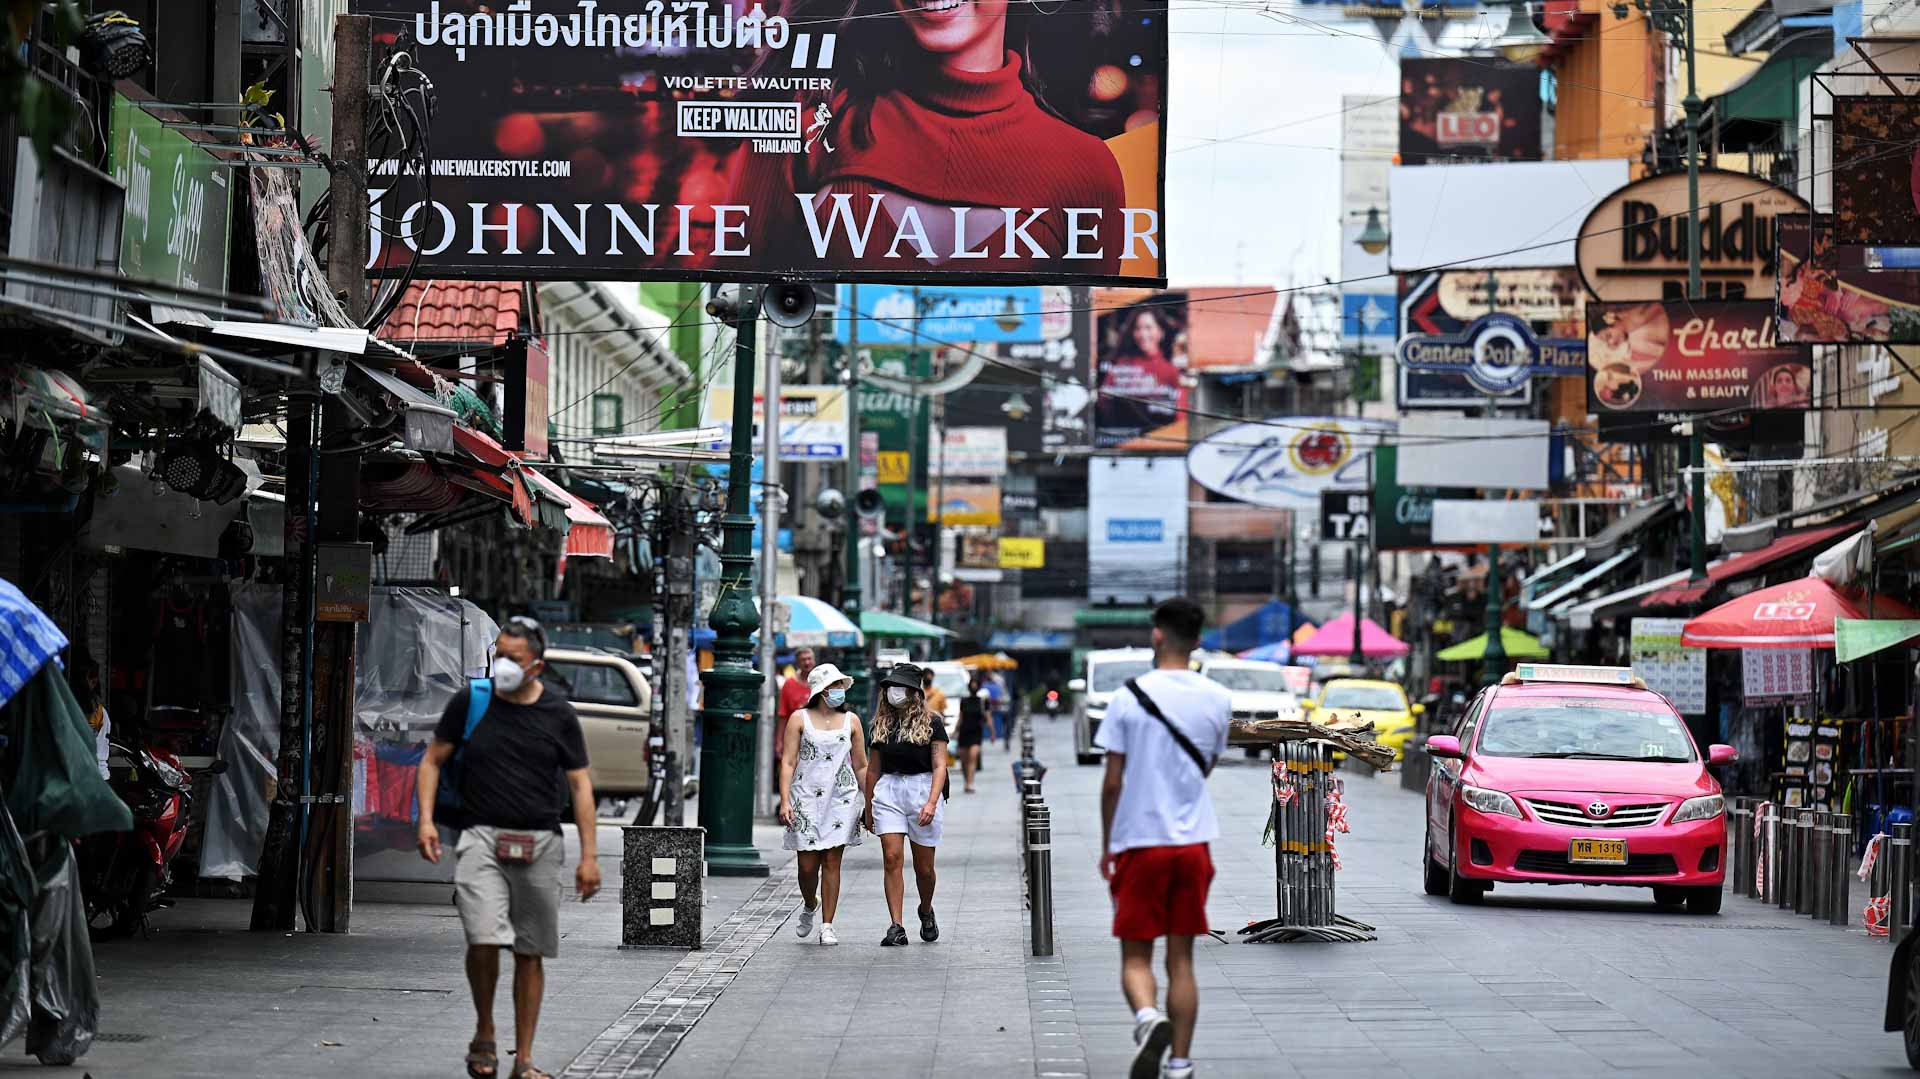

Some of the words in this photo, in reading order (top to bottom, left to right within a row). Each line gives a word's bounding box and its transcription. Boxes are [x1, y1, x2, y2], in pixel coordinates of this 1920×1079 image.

[663, 76, 747, 90] VIOLETTE
[752, 77, 832, 91] WAUTIER
[683, 108, 721, 131] KEEP
[725, 108, 796, 131] WALKING
[1442, 116, 1496, 138] LEO
[752, 139, 801, 153] THAILAND
[366, 189, 752, 269] JOHNNIE
[794, 192, 1159, 260] WALKER
[1622, 200, 1776, 276] Buddy
[1407, 342, 1474, 363] Center
[1481, 343, 1533, 366] Point
[1653, 369, 1682, 381] THAI
[1686, 367, 1748, 381] MASSAGE
[1686, 386, 1697, 399] &
[1700, 385, 1750, 398] BEAUTY
[1758, 605, 1813, 619] LEO
[1598, 843, 1622, 854] 1319
